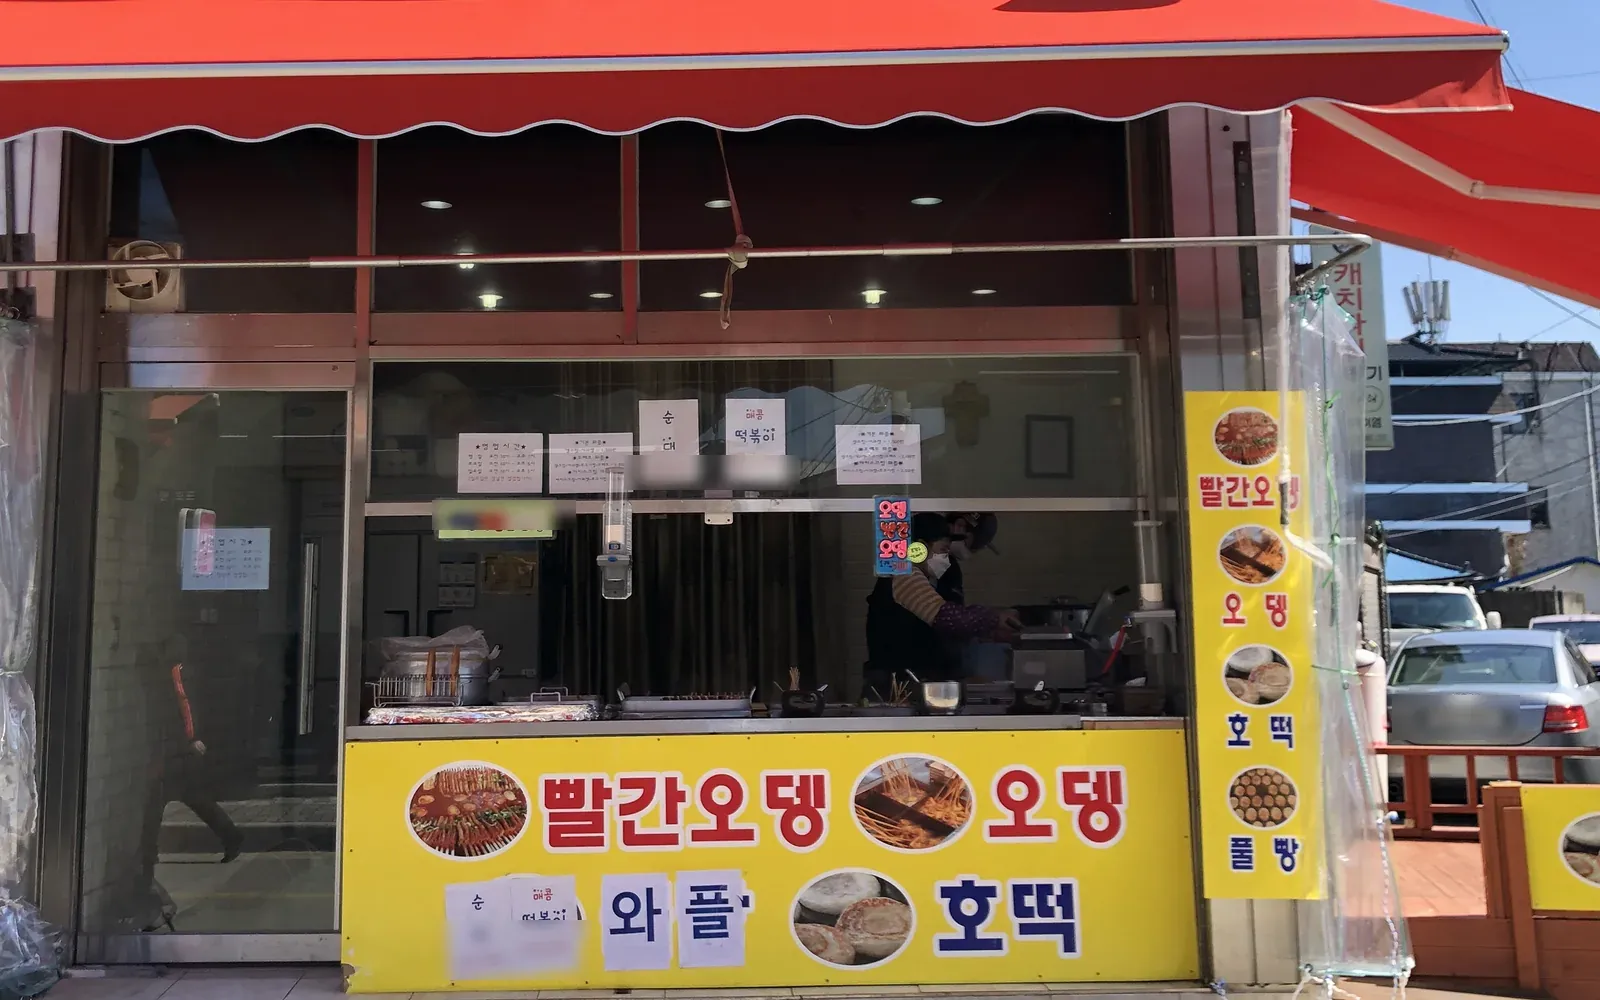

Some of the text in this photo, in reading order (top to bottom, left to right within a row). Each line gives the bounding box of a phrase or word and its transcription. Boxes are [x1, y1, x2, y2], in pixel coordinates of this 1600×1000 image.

[735, 428, 775, 444] 떡볶이
[879, 500, 907, 519] 오뎅
[879, 540, 907, 559] 오뎅
[544, 769, 1124, 849] 빨간오뎅 오뎅
[939, 879, 1077, 953] 호떡
